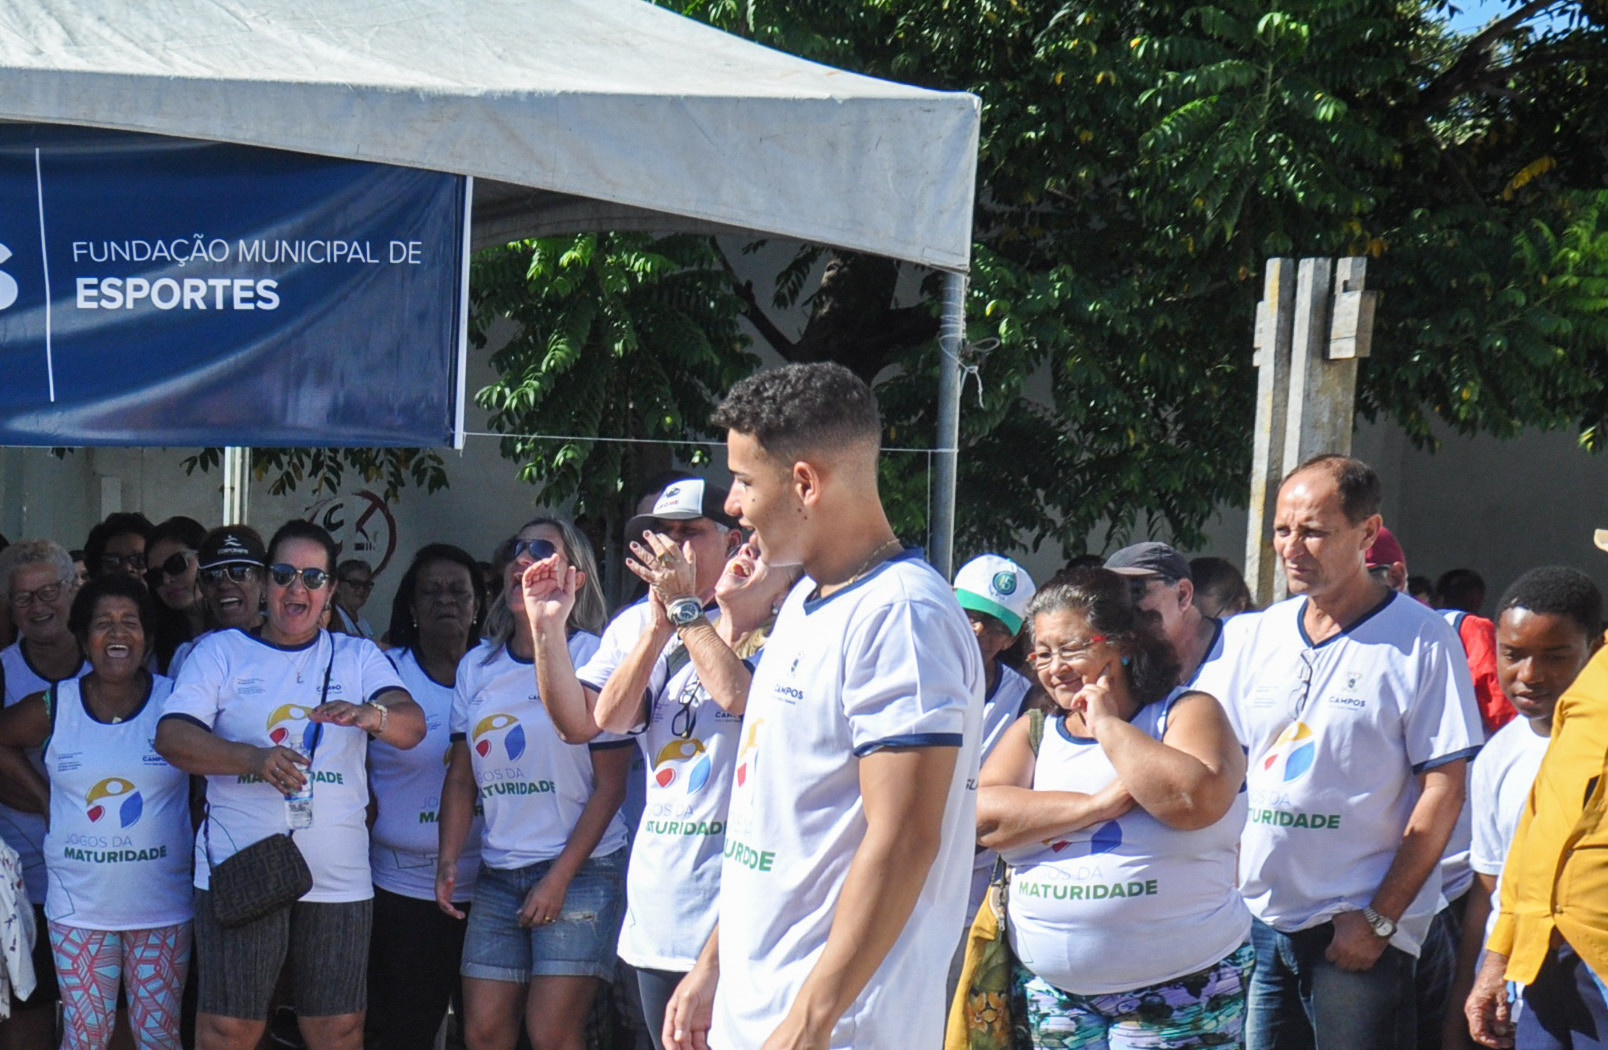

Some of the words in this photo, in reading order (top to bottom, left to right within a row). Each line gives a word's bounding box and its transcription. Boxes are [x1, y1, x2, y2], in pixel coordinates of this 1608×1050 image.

[72, 233, 230, 267] FUNDAÇÃO
[238, 239, 380, 264] MUNICIPAL
[389, 241, 422, 264] DE
[75, 277, 280, 310] ESPORTES
[64, 833, 108, 848] JOGOS
[112, 836, 133, 848] DA
[63, 845, 167, 864] MATURIDADE
[1018, 879, 1159, 900] MATURIDADE
